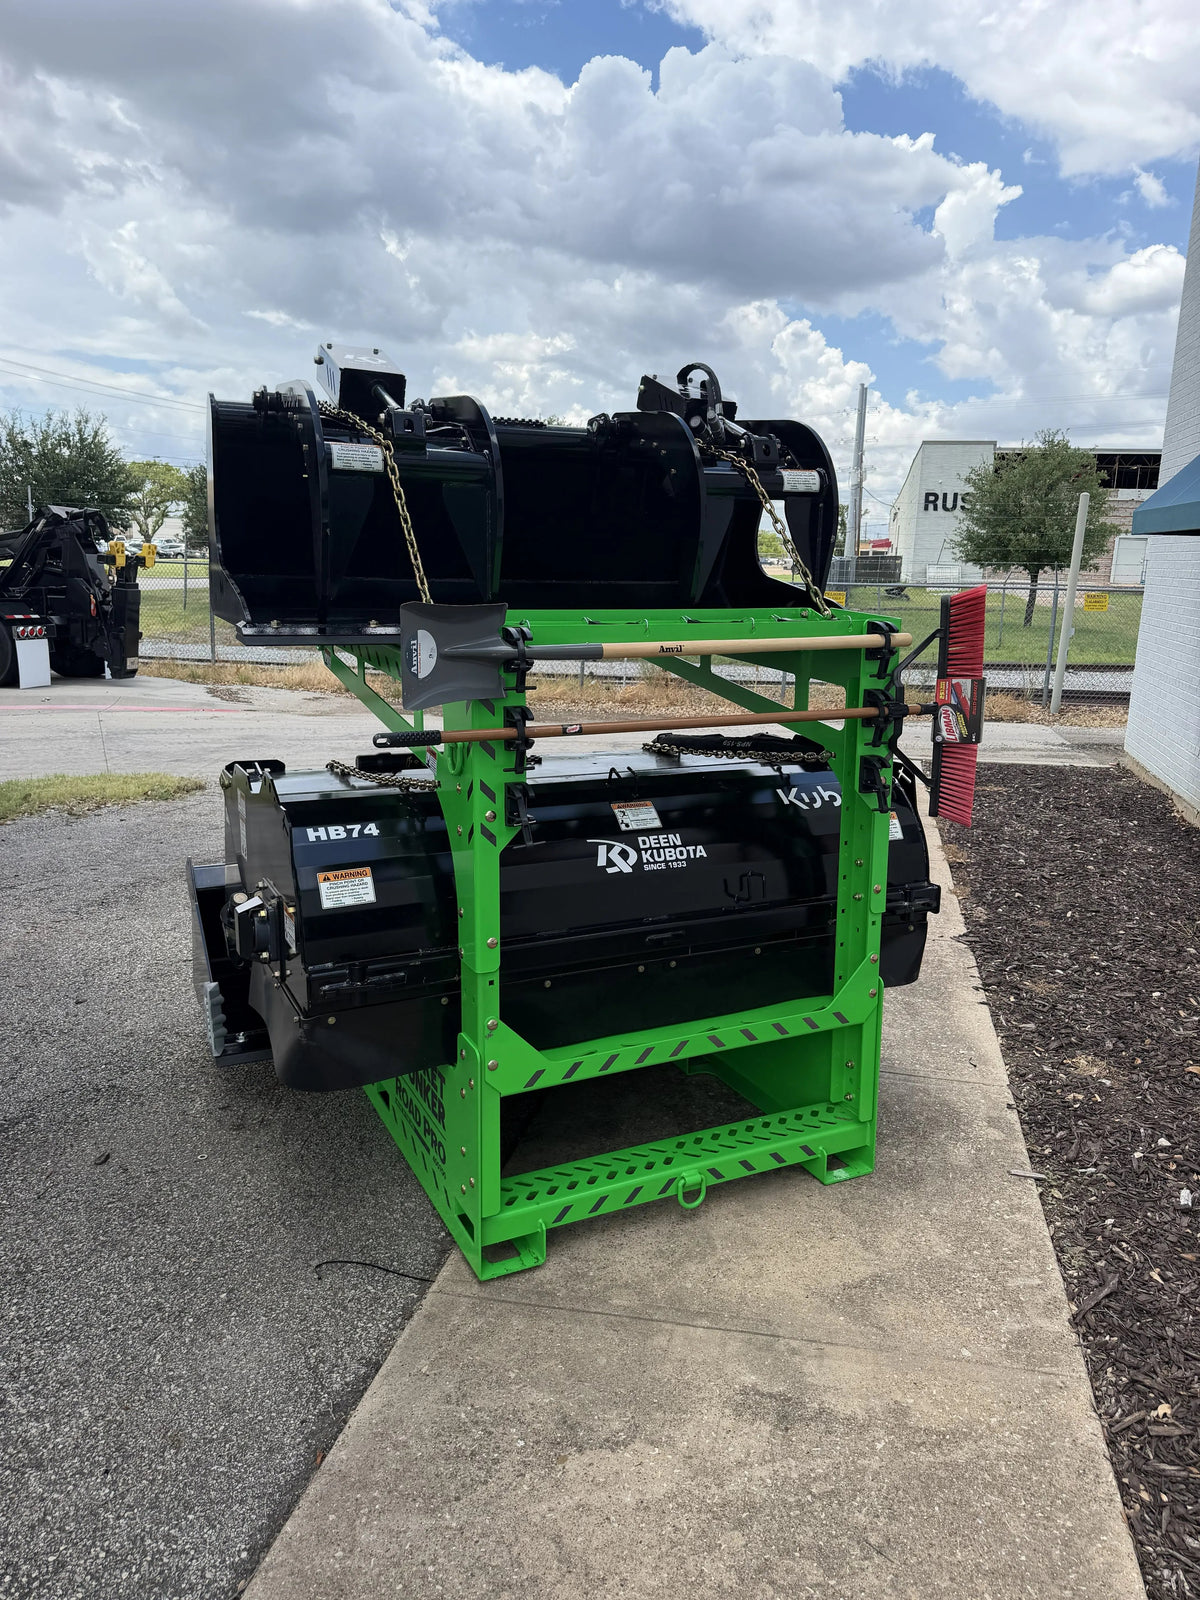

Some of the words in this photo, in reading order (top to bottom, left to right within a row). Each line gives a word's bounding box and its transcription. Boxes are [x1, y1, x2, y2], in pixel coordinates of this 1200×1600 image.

[924, 492, 970, 512] RUS
[658, 644, 683, 653] Anvil
[942, 708, 958, 742] LIBMAN
[776, 785, 842, 810] Kub
[306, 823, 380, 842] HB74
[637, 833, 682, 849] DEEN
[641, 845, 708, 863] KUBOTA
[332, 869, 368, 880] WARNING
[643, 862, 667, 871] SINCE
[668, 860, 687, 869] 1933
[409, 1070, 446, 1132] UNKER
[395, 1077, 421, 1127] ROAD
[423, 1115, 446, 1165] PRO
